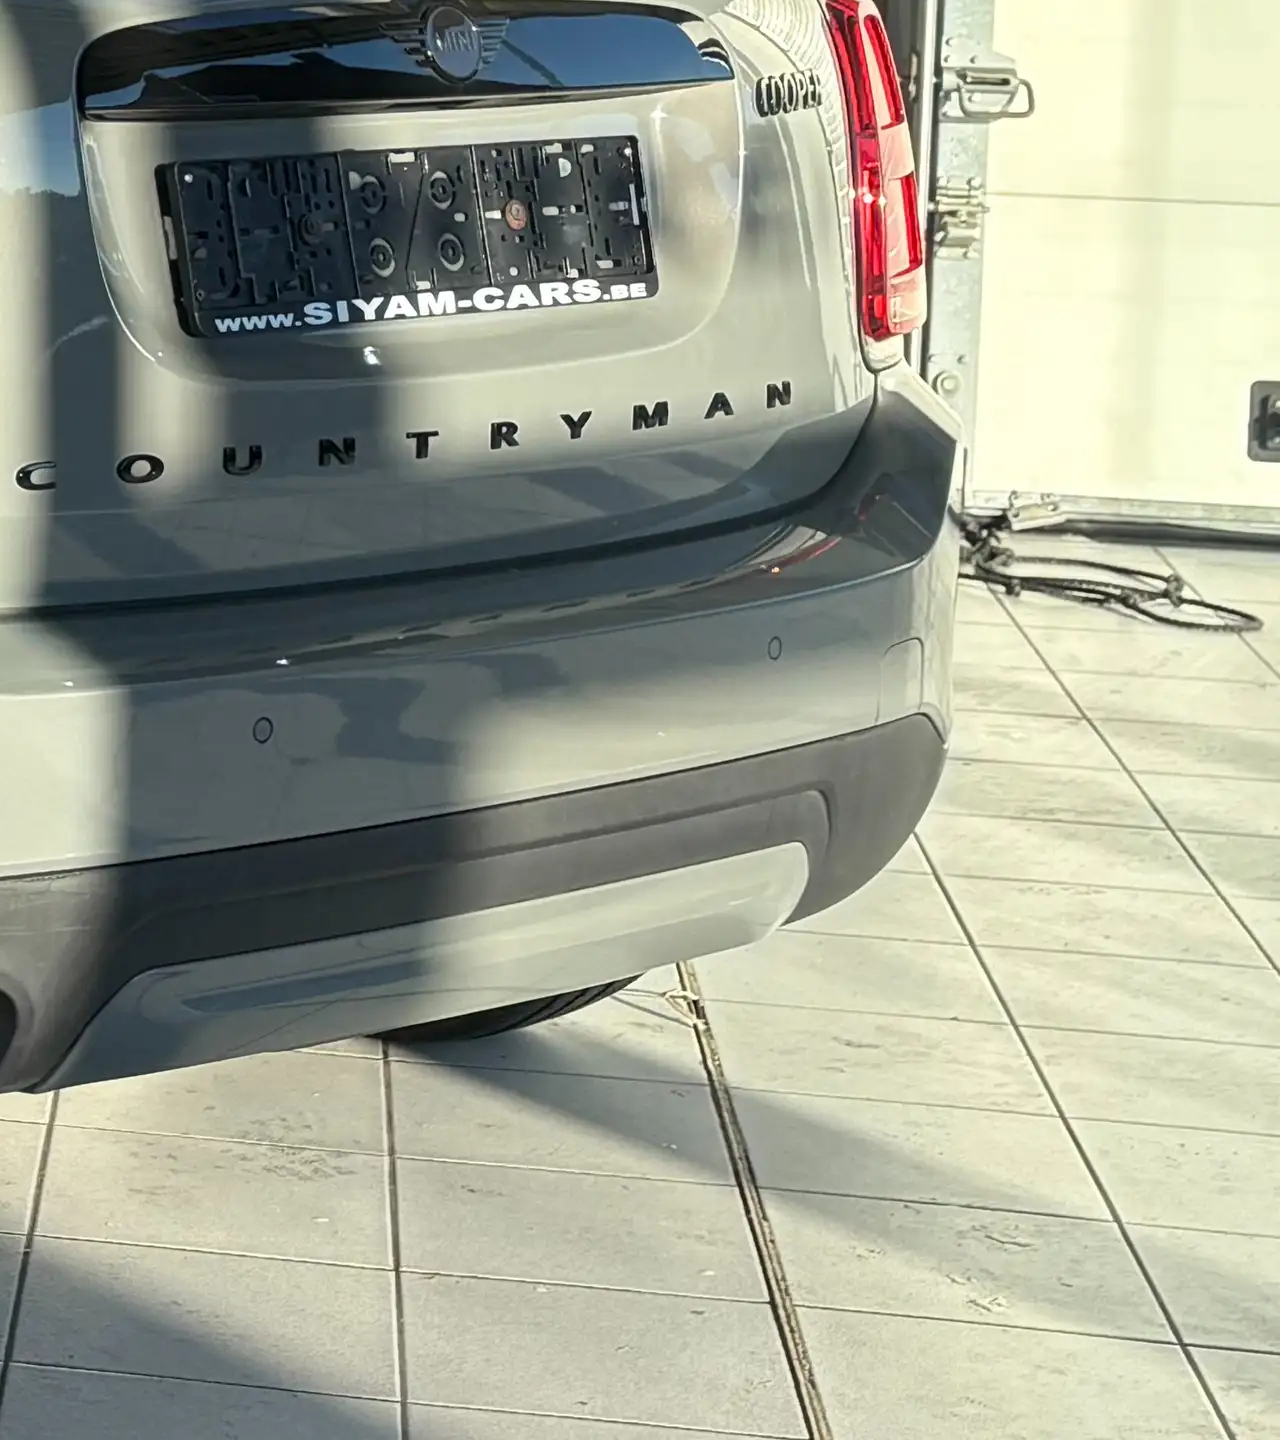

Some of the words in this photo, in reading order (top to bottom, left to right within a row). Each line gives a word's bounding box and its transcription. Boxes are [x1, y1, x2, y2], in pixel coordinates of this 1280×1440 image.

[435, 31, 479, 53] MINI
[754, 68, 823, 118] COOPER
[214, 278, 648, 334] www.SIYAM-CARS.BE
[14, 380, 793, 492] COUNTRYMAN
